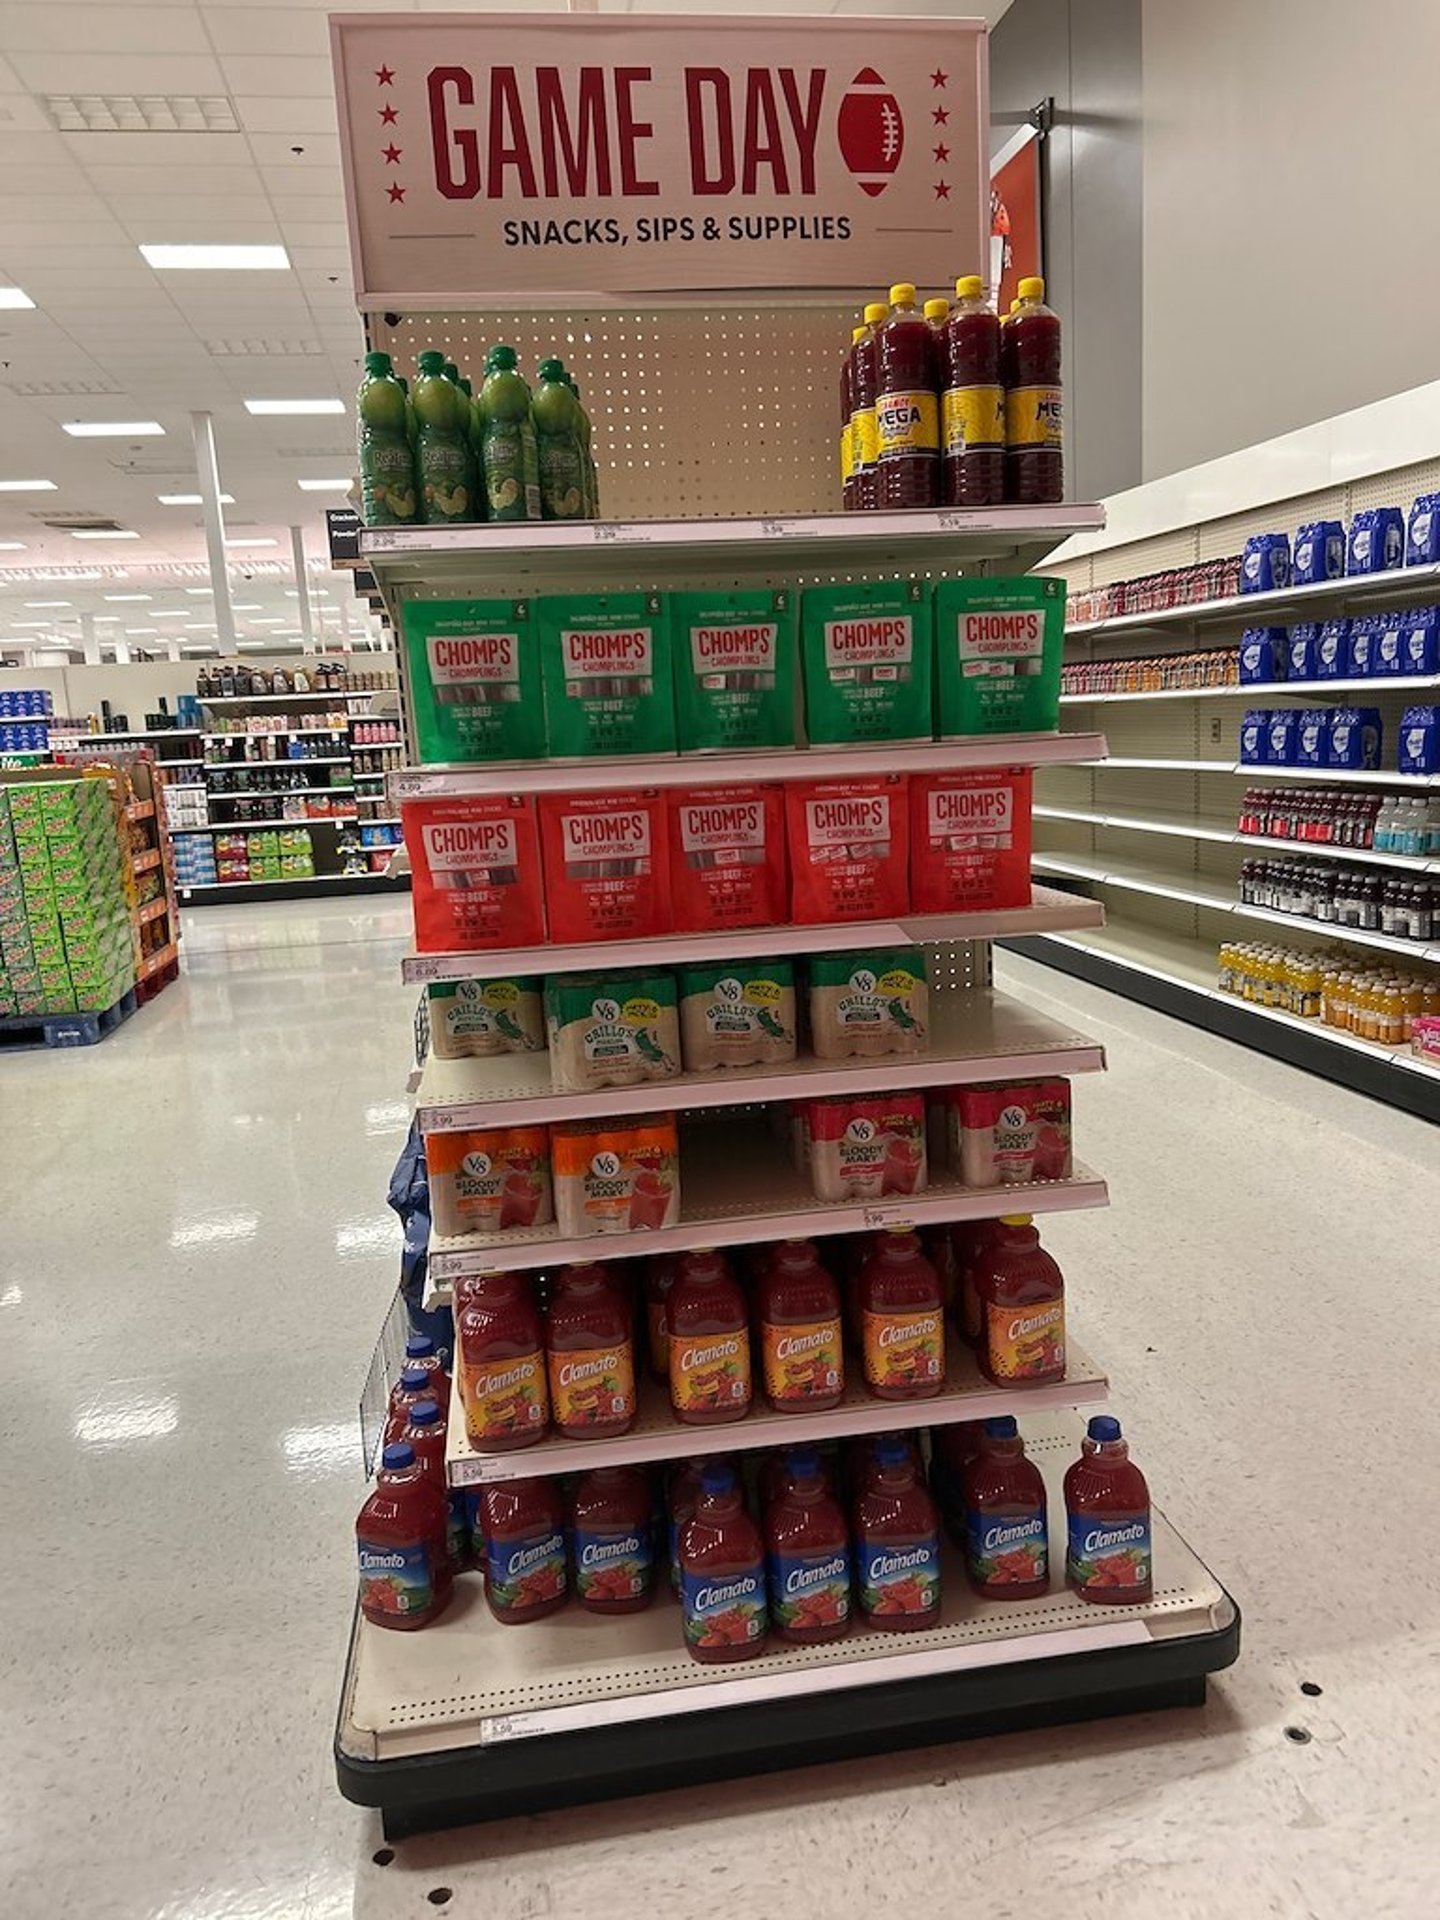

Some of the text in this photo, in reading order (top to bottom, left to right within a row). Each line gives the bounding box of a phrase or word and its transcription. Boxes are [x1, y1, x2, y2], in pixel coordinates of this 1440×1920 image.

[427, 66, 826, 199] GAME DAY
[503, 216, 852, 246] SNACKS, SIPS & SUPPLIES
[698, 627, 770, 656] CHOMPS
[832, 621, 905, 650] CHOMPS
[966, 614, 1038, 643] CHOMPS
[434, 638, 511, 667] CHOMPS
[568, 632, 646, 661] CHOMPS
[688, 806, 757, 835] CHOMPS
[814, 801, 882, 828] CHOMPS
[936, 793, 1006, 820] CHOMPS
[430, 824, 508, 854] CHOMPS
[568, 814, 643, 845] CHOMPS
[460, 983, 478, 999] V8
[719, 983, 738, 1000] V8
[854, 973, 872, 992] V8
[596, 1002, 615, 1020] V8
[851, 1122, 870, 1139] V8
[1003, 1109, 1021, 1126] V8
[839, 1145, 884, 1157] BLOODY
[993, 1132, 1035, 1145] BLOODY
[998, 1141, 1028, 1151] MARY
[468, 1156, 486, 1174] V8
[596, 1156, 615, 1175] V8
[845, 1154, 877, 1165] MARY
[456, 1179, 501, 1191] BLOODY
[462, 1186, 496, 1197] MARY
[584, 1180, 629, 1192] BLOODY
[590, 1187, 625, 1198] MARY
[878, 1318, 937, 1348] Clamato
[1007, 1307, 1062, 1341] Clamato
[680, 1340, 739, 1371] Clamato
[776, 1328, 834, 1360] Clamato
[475, 1363, 536, 1398] Clamato
[560, 1354, 618, 1386] Clamato
[984, 1518, 1043, 1548] Clamato
[1083, 1523, 1145, 1553] Clamato
[359, 1551, 405, 1569] Clamato
[507, 1534, 564, 1575] Clamato
[582, 1536, 640, 1564] Clamato
[869, 1548, 930, 1580] Clamato
[786, 1556, 846, 1593] Clamato
[694, 1576, 757, 1612] Clamato
